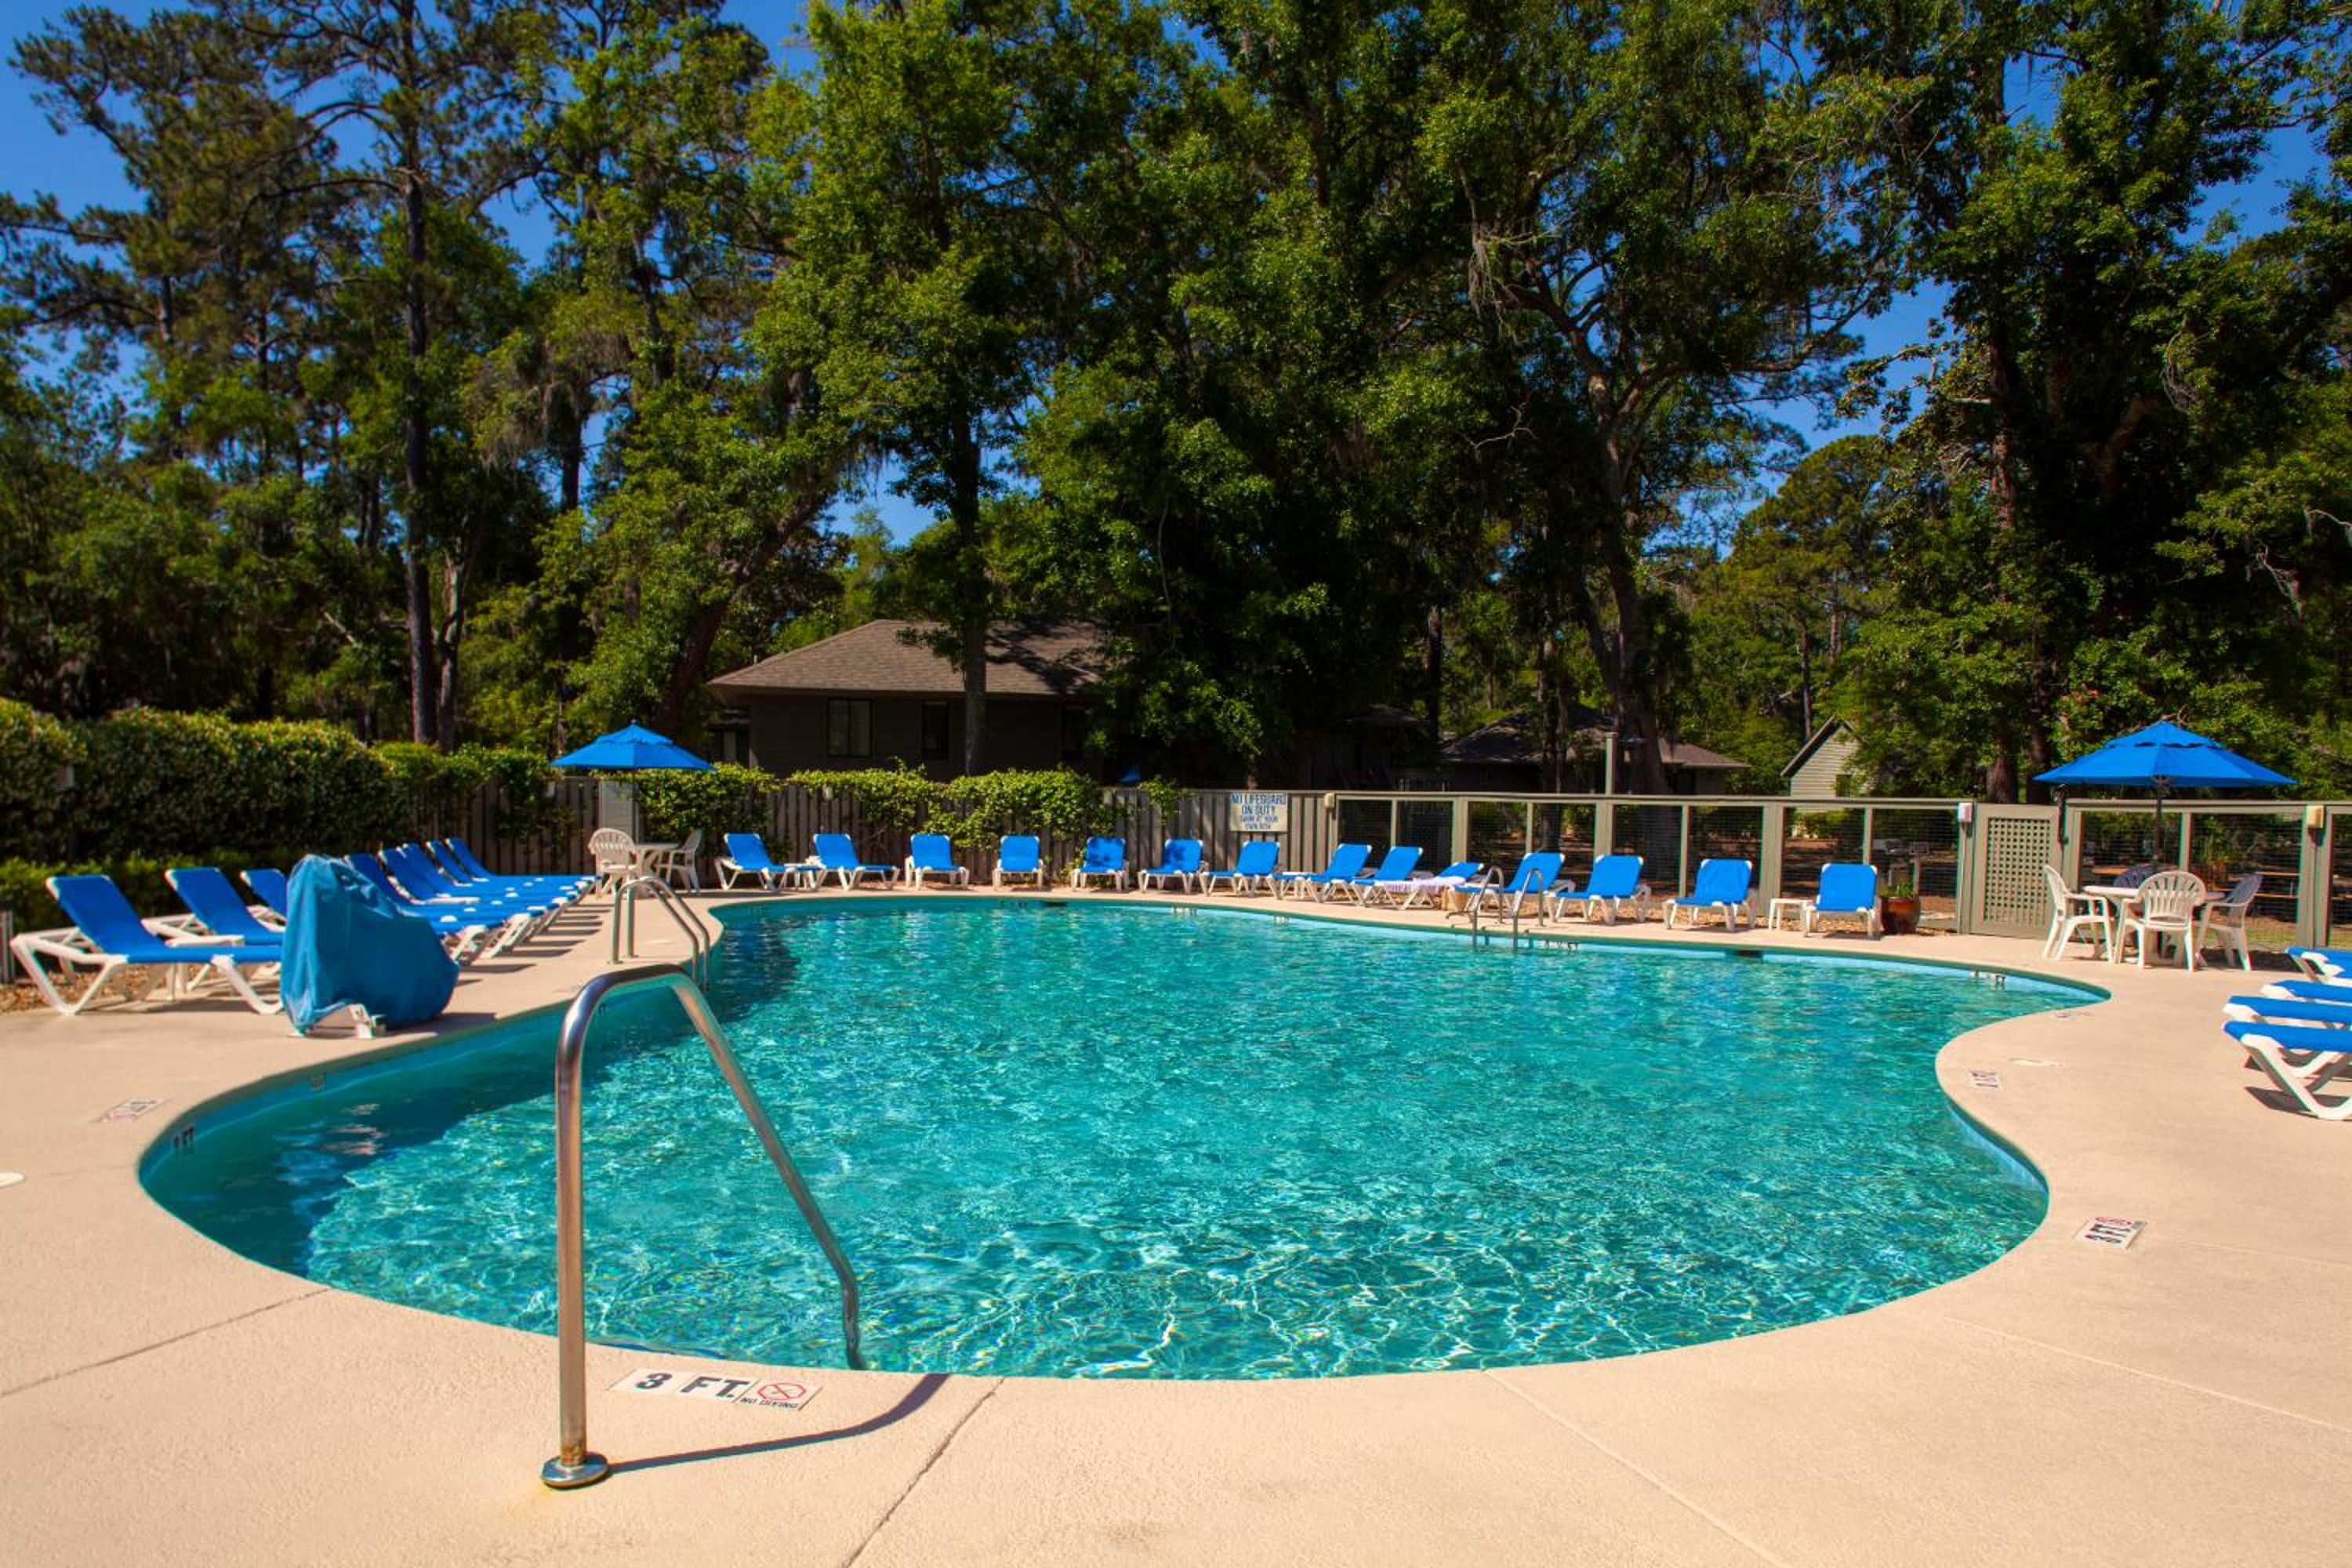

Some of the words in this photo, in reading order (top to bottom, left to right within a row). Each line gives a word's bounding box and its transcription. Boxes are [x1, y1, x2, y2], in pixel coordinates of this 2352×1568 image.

[1230, 793, 1243, 804] NO
[1244, 793, 1286, 804] LIFEGUARD
[1241, 804, 1253, 815] ON
[1254, 805, 1276, 815] DUTY
[635, 1372, 673, 1391] 3
[680, 1375, 752, 1399] FT.
[739, 1396, 758, 1405] NO
[759, 1399, 800, 1410] DIVING
